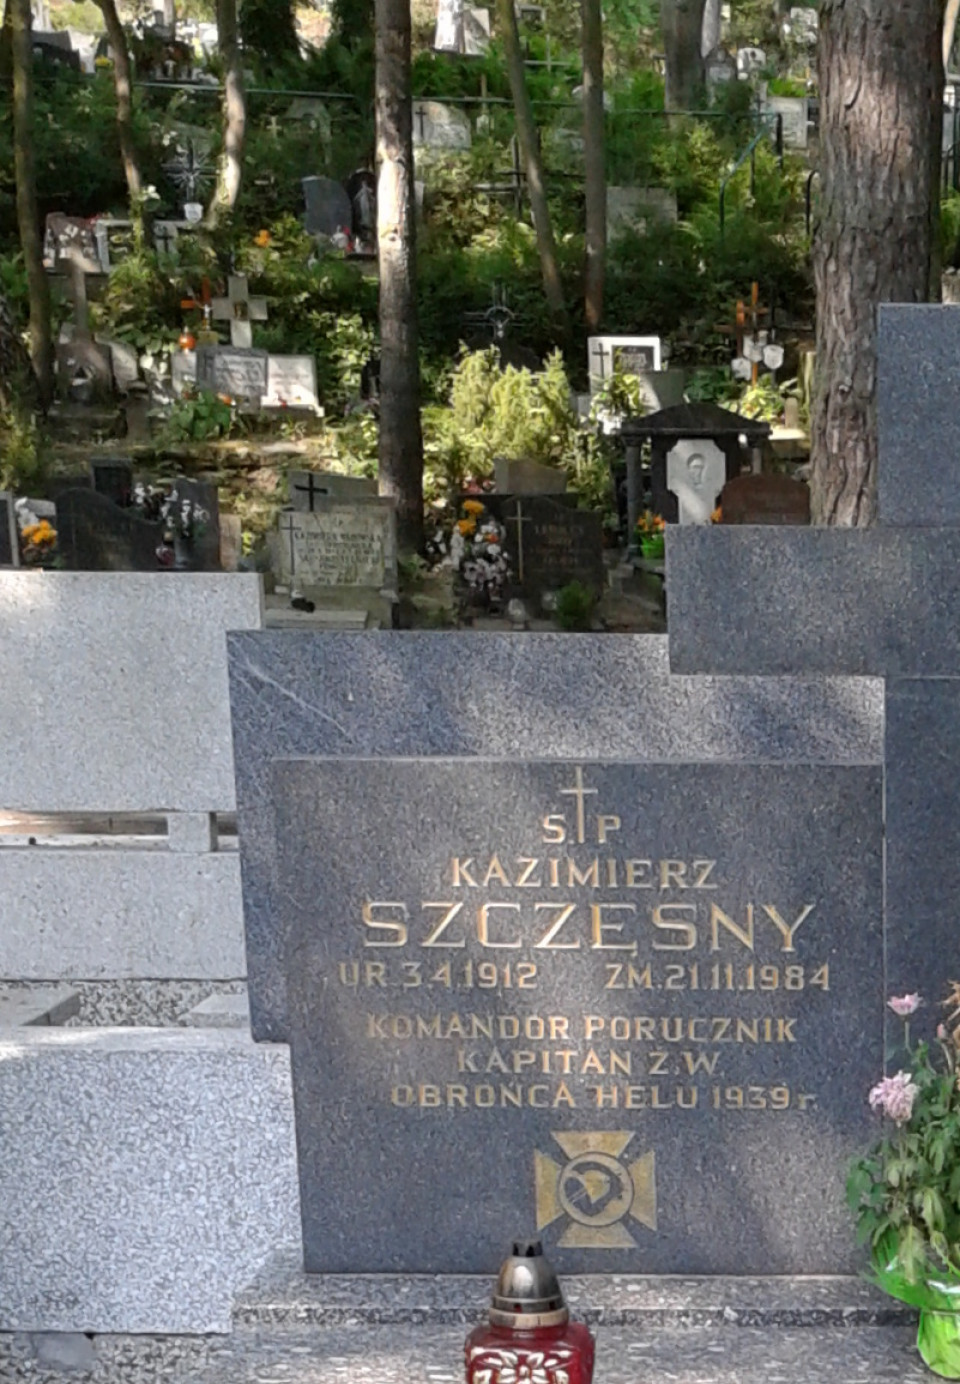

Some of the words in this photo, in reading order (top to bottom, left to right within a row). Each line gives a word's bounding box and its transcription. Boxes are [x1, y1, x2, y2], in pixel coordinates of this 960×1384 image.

[451, 855, 719, 889] KAZIMIERZ
[362, 901, 817, 957] SZCZĘSNY
[367, 1012, 570, 1040] KOMANDOR
[583, 1014, 798, 1043] PORUCZNIK
[457, 1046, 632, 1076] KAPITAN
[594, 1083, 698, 1110] HELU
